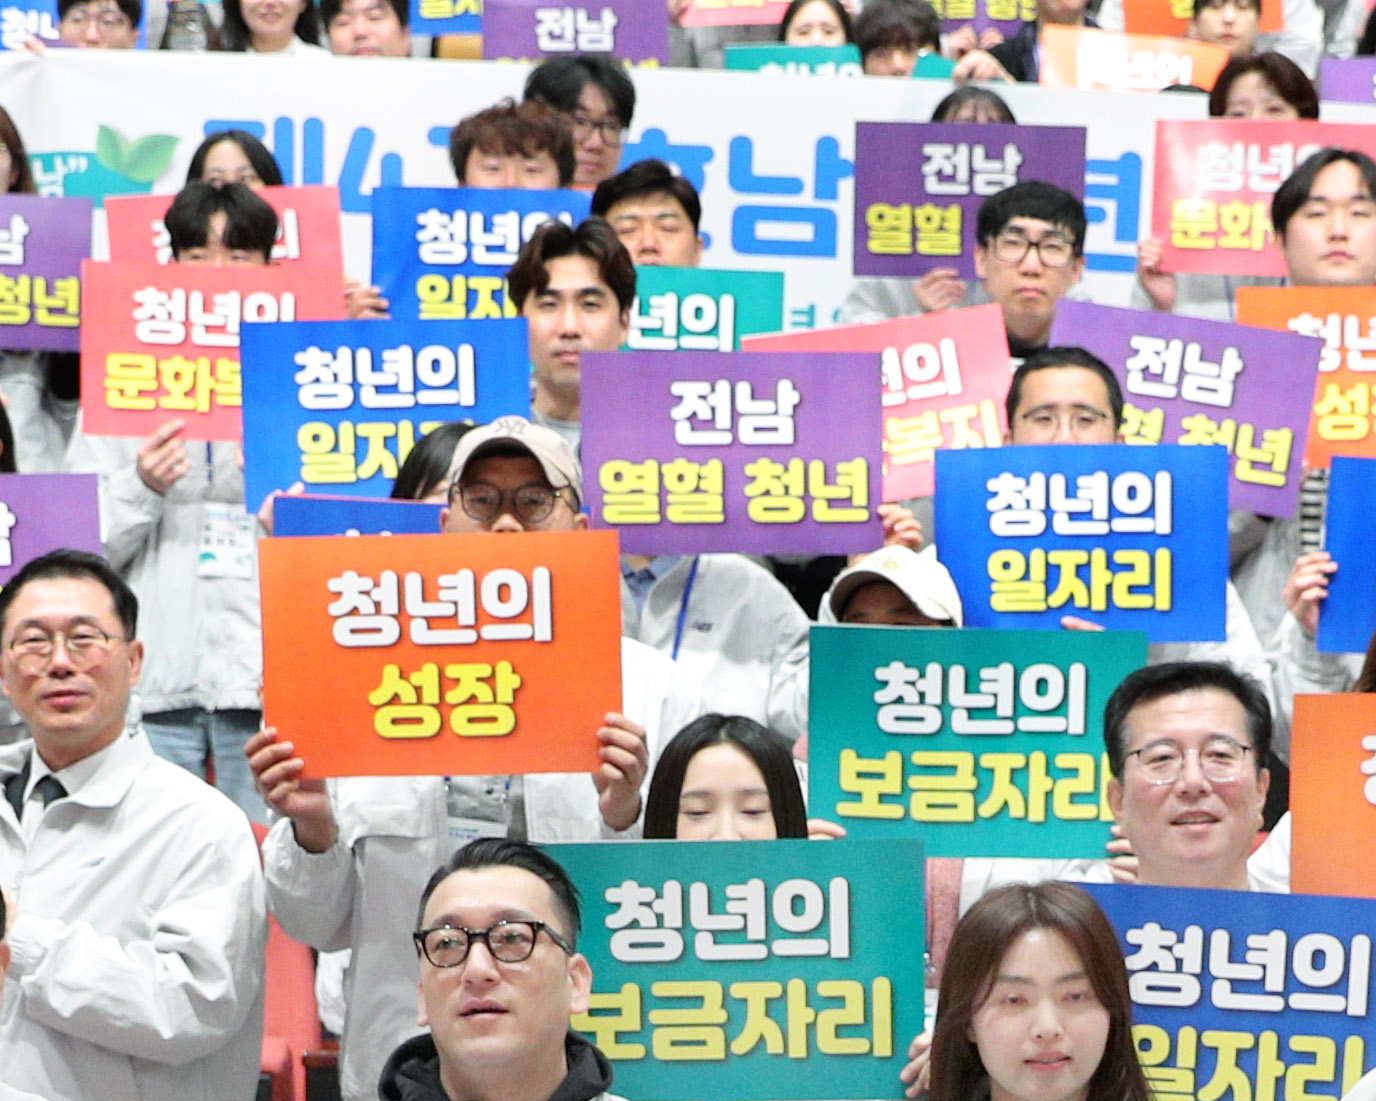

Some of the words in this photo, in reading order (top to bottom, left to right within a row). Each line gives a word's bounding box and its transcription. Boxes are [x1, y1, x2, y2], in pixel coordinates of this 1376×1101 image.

[535, 10, 618, 52] 전남
[921, 143, 1021, 195] 전남
[1199, 142, 1312, 193] 청년
[866, 203, 962, 255] 열혈
[1171, 200, 1274, 250] 문화
[132, 287, 296, 347] 청년의
[417, 275, 517, 318] 일자
[628, 292, 734, 352] 년의
[104, 352, 242, 412] 문화
[293, 343, 476, 410] 청년의
[1126, 334, 1244, 407] 전남
[670, 379, 801, 446] 전남
[882, 399, 1002, 466] 복지
[297, 418, 456, 484] 일자
[599, 458, 725, 524] 열혈
[744, 456, 870, 523] 청년
[986, 471, 1173, 538] 청년의
[328, 566, 553, 647] 청년의
[987, 547, 1173, 612] 일자리
[369, 661, 521, 738] 성장
[874, 661, 1086, 735] 청년의
[836, 749, 1114, 822] 보금자리
[604, 876, 850, 963] 청년의
[1125, 922, 1370, 1017] 청년의
[570, 976, 893, 1060] 보금자리
